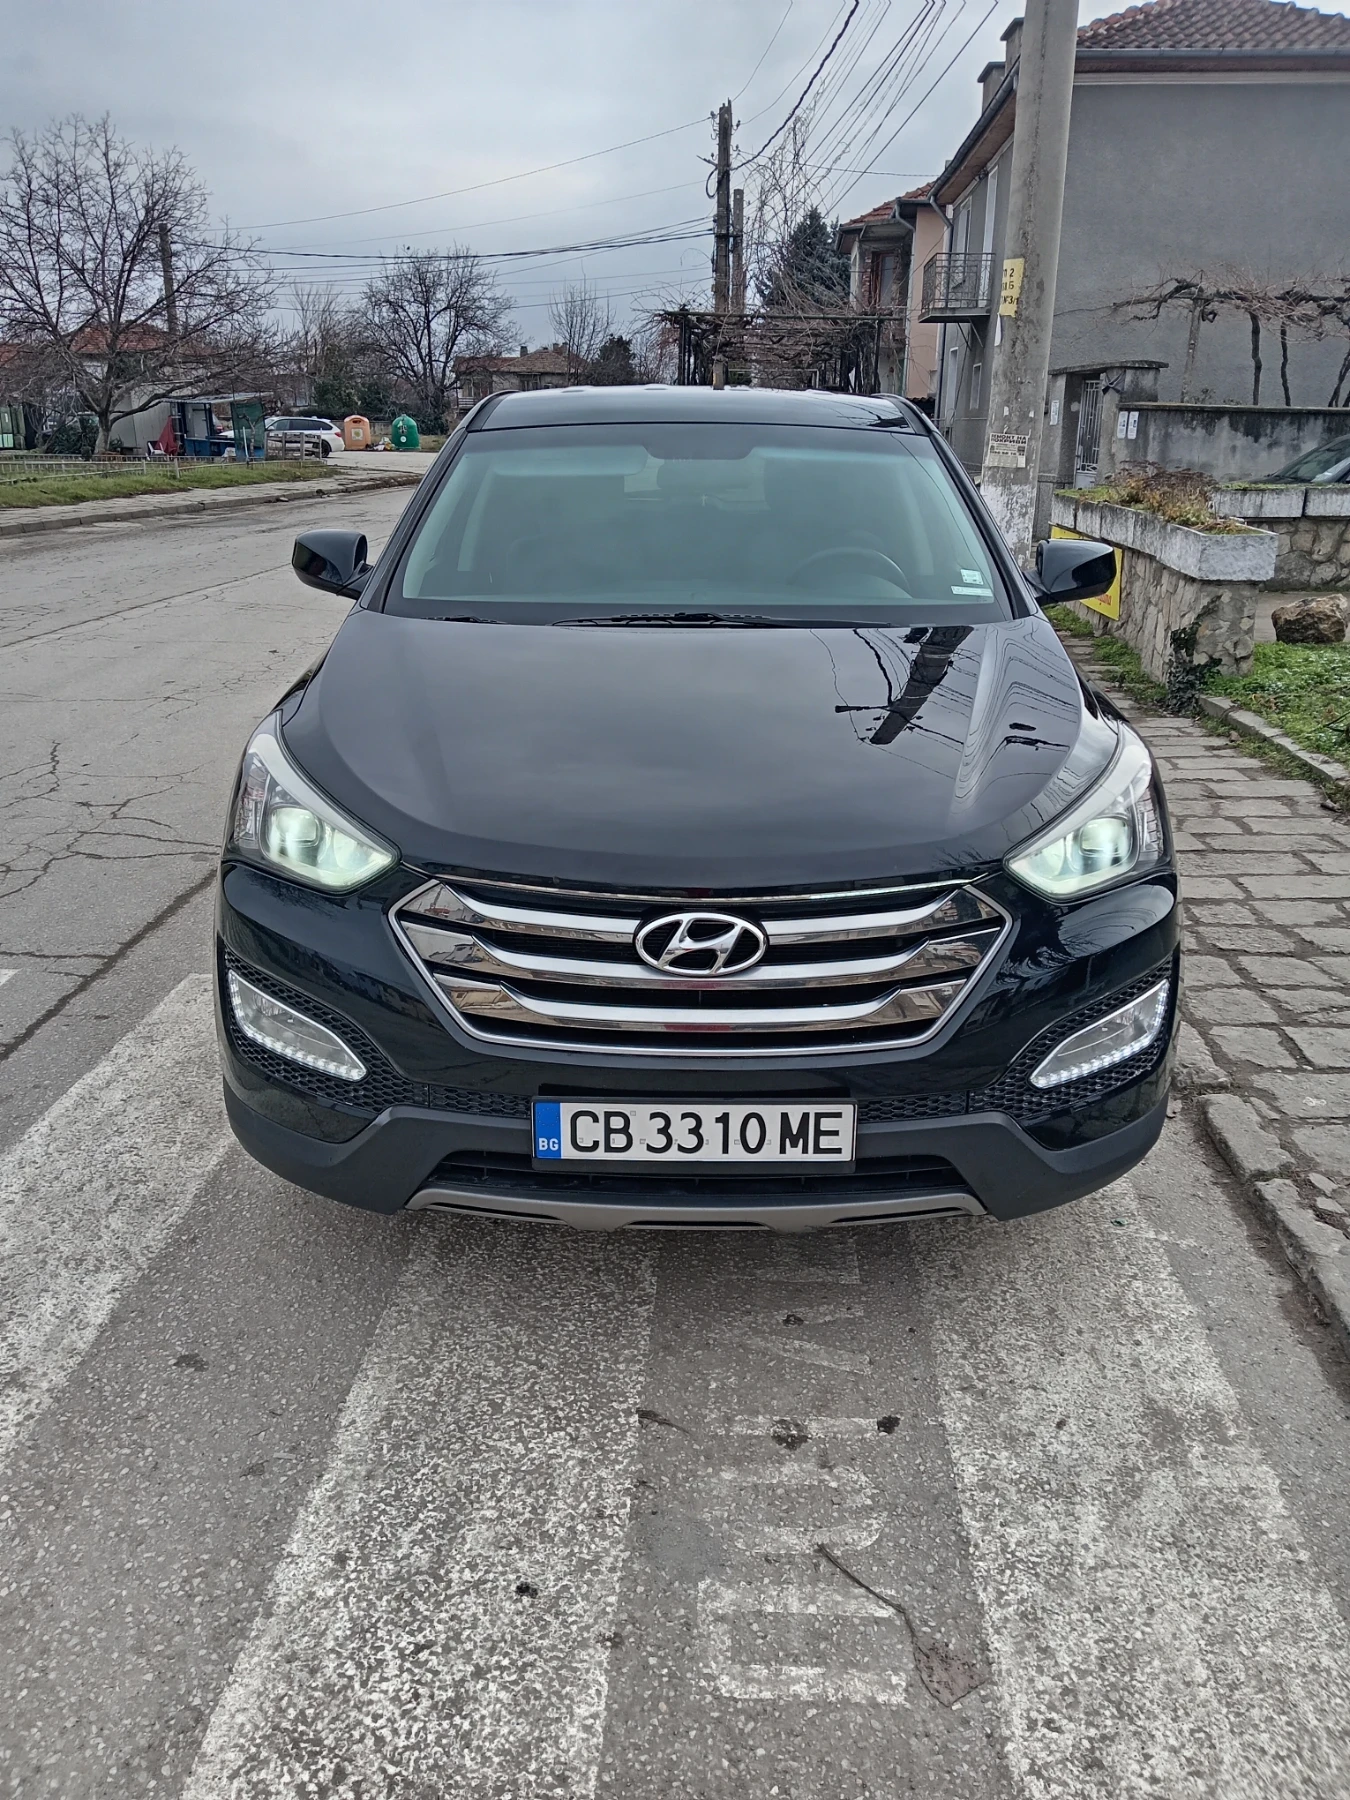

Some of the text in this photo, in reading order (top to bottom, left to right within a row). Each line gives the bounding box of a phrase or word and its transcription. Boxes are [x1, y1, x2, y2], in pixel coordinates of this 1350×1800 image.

[538, 1137, 559, 1151] BG
[569, 1110, 843, 1155] CB 3310 ME
